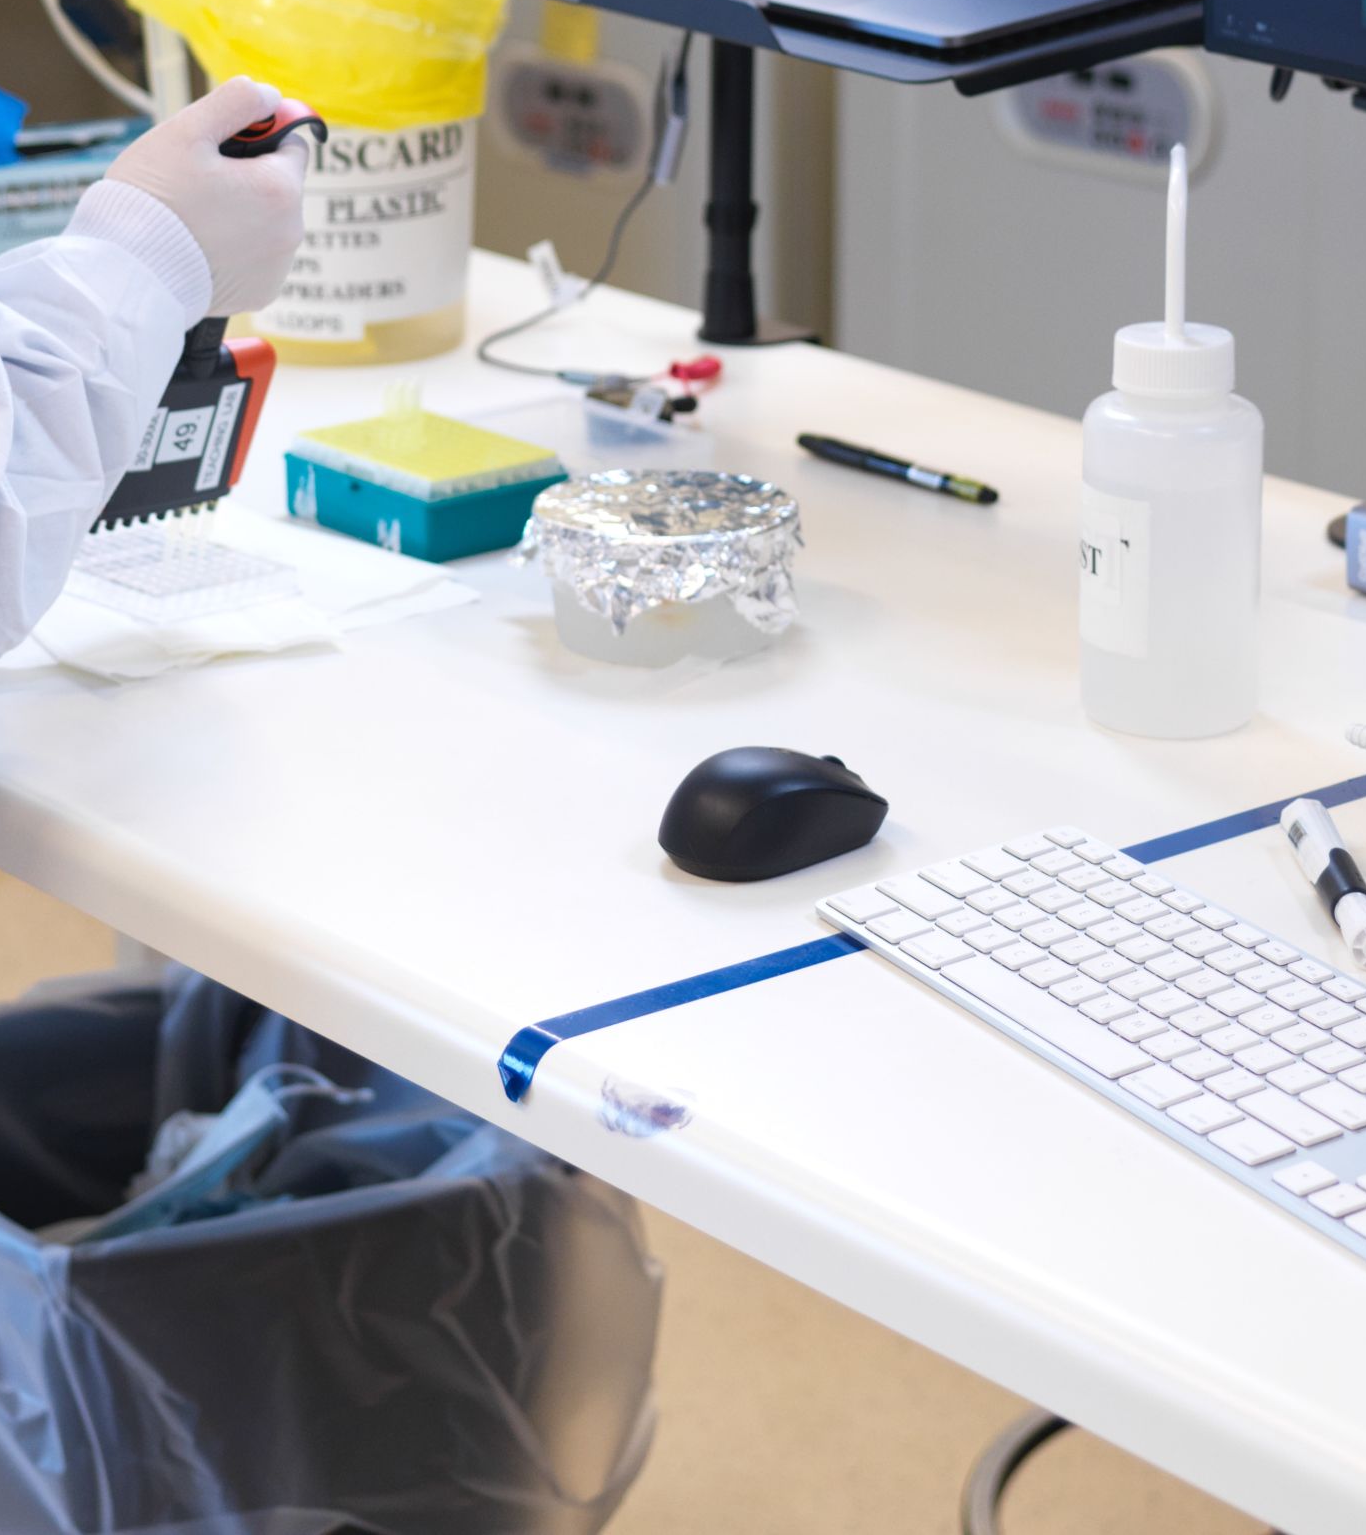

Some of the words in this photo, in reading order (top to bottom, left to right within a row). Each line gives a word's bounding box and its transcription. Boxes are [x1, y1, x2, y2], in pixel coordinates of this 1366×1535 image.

[314, 121, 464, 174] ISCARD
[280, 278, 405, 302] PREADERS
[1078, 545, 1102, 577] ST
